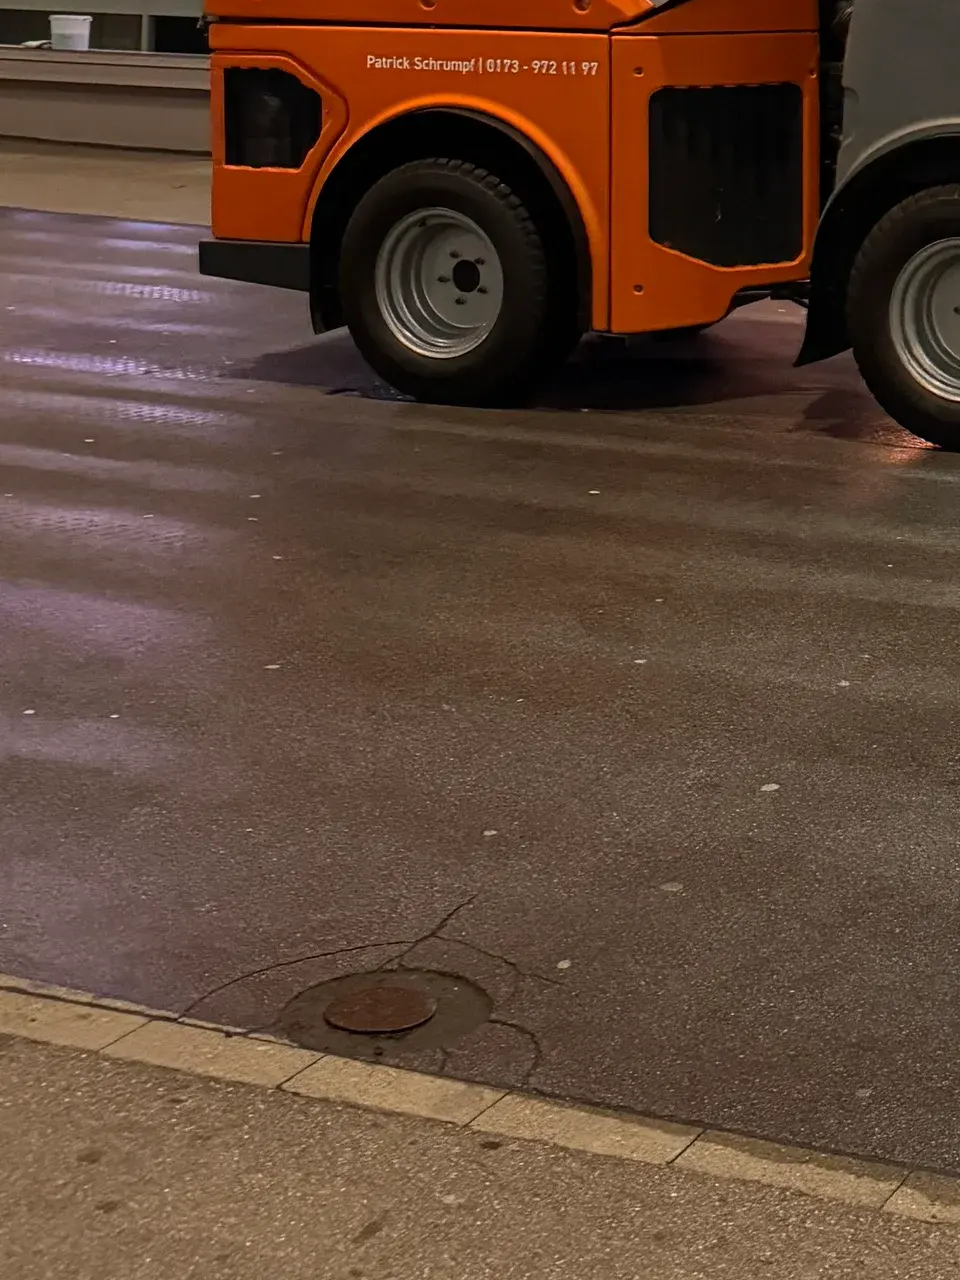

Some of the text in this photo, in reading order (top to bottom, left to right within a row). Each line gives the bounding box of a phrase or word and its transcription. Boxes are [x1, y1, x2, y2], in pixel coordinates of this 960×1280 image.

[366, 55, 410, 70] Patrick
[413, 57, 475, 75] Schrumpf
[486, 59, 520, 73] 0173
[531, 60, 557, 74] 972
[562, 61, 577, 75] 11
[582, 62, 599, 75] 97
